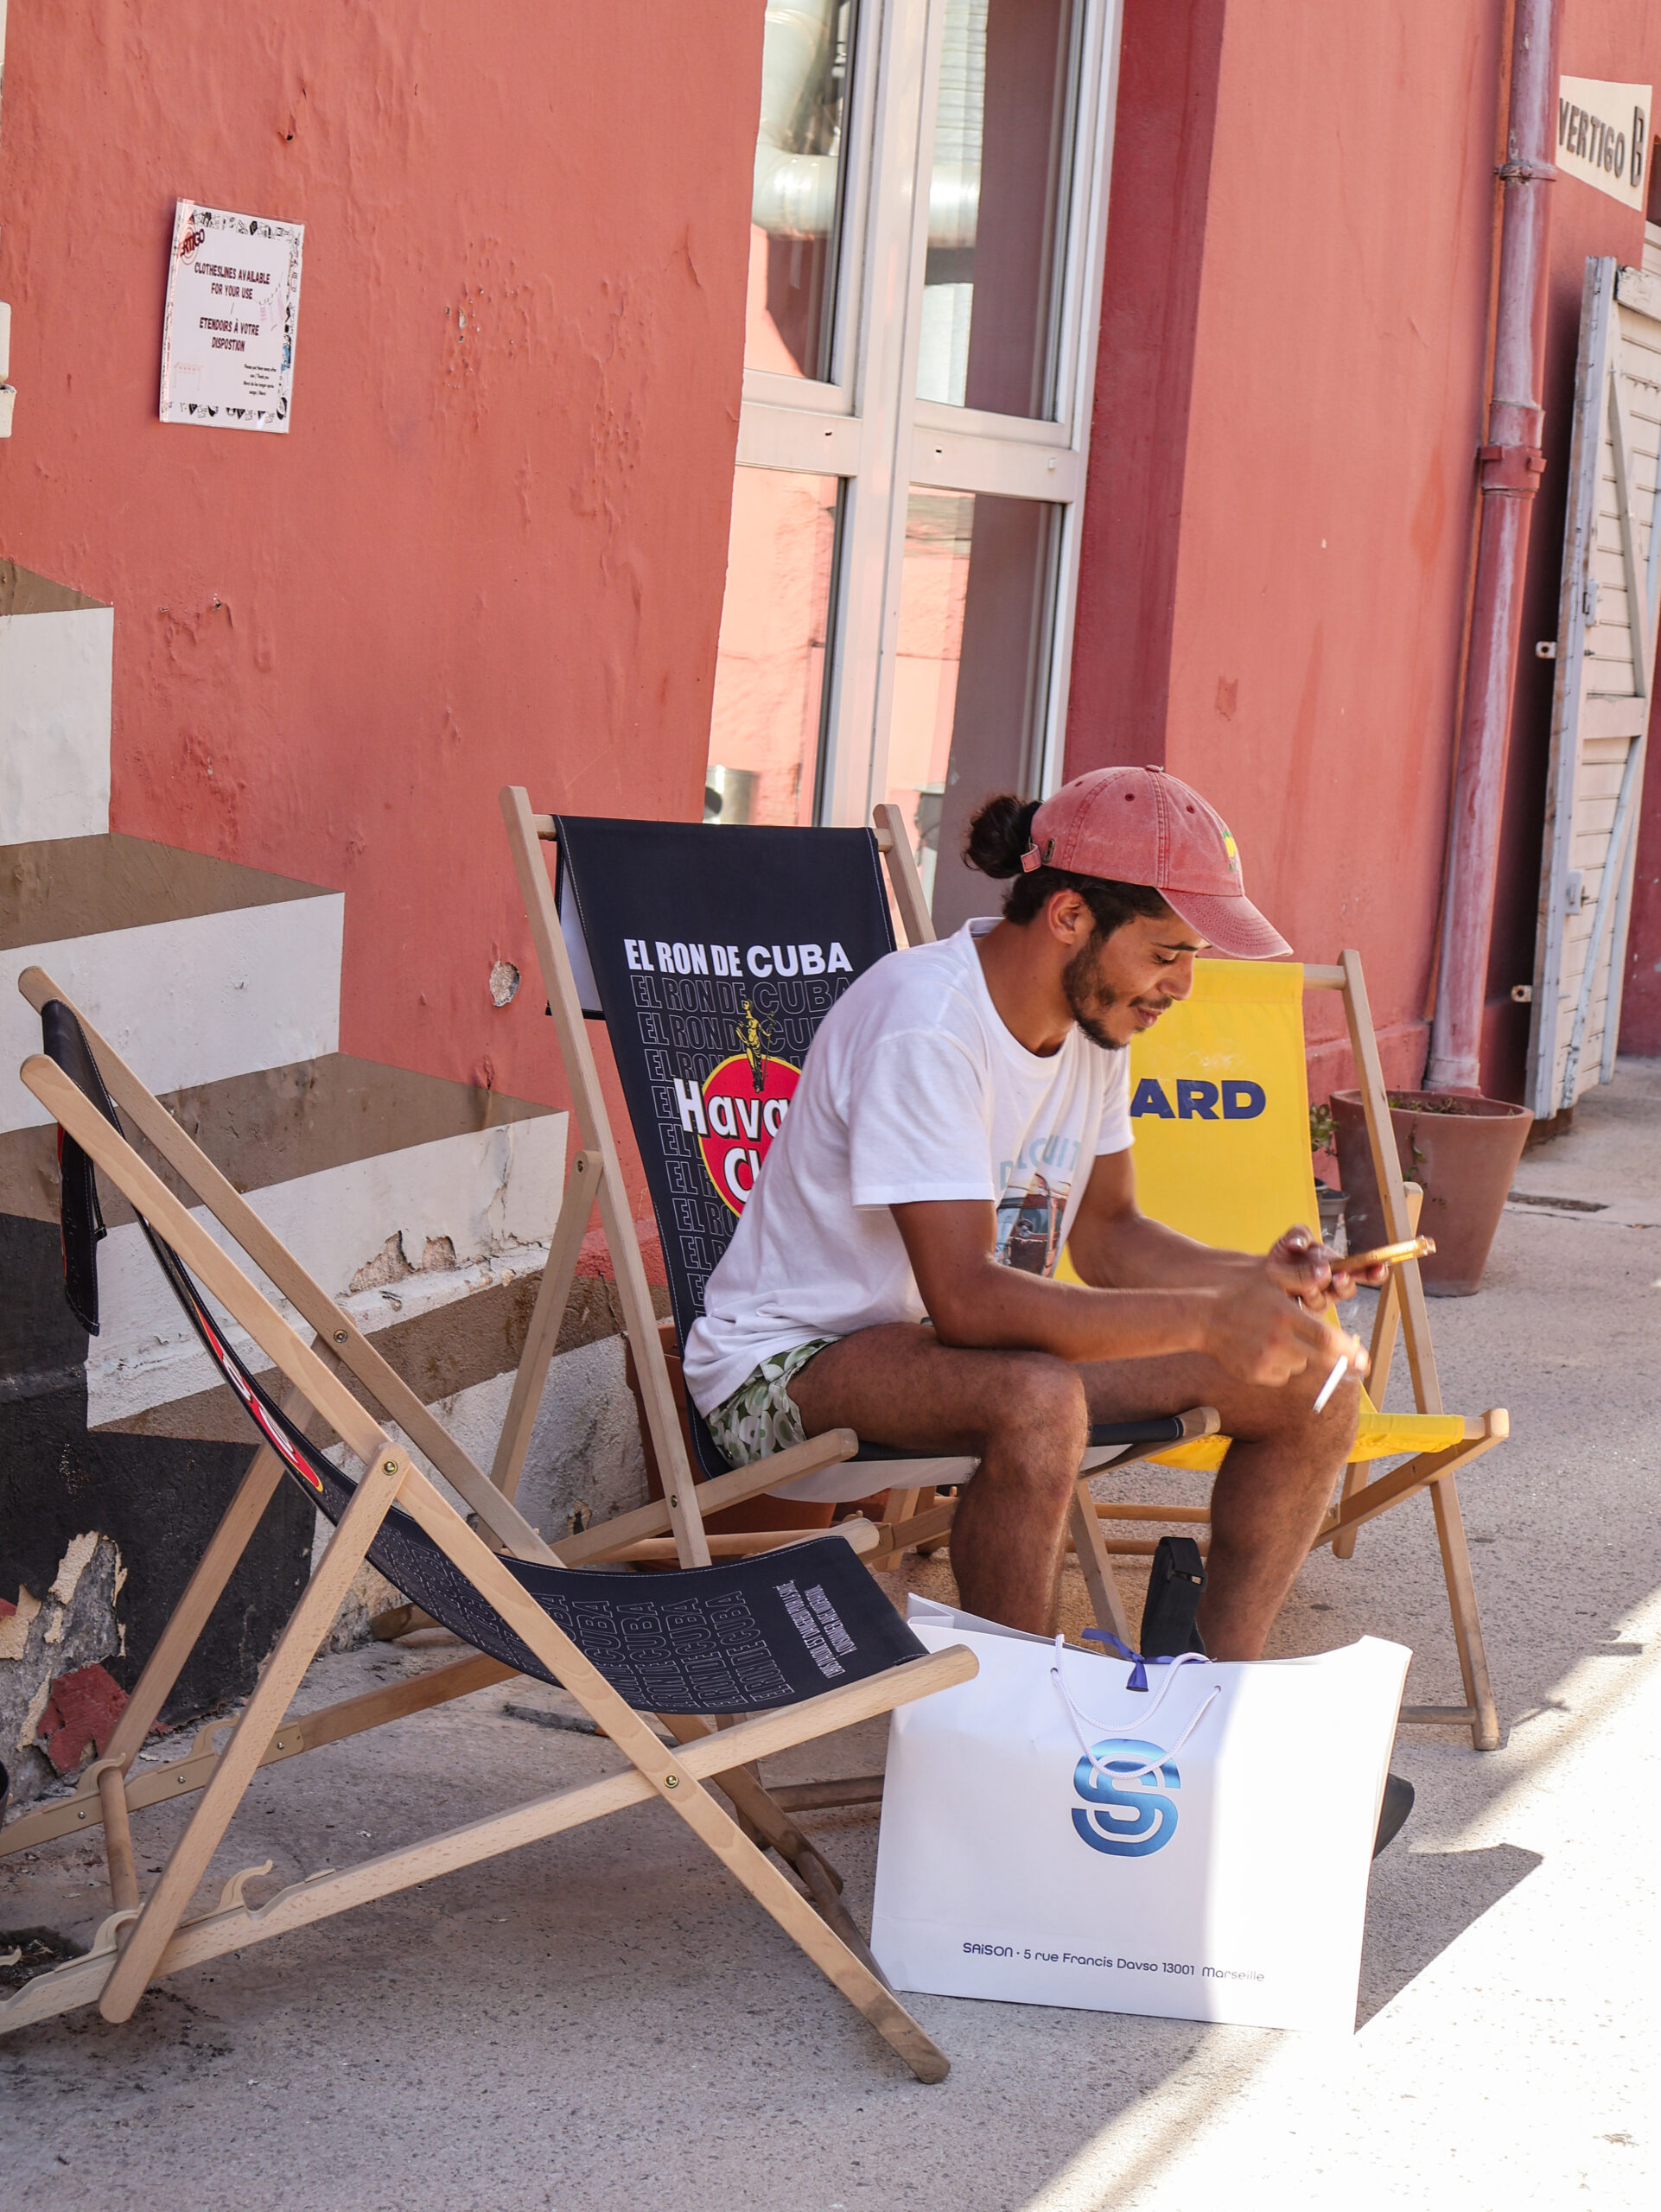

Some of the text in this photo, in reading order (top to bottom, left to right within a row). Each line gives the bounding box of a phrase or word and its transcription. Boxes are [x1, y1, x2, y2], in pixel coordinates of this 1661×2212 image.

[1559, 98, 1645, 188] VERTIGO B
[194, 262, 270, 284] CLOTHESLINES AVAILABLE
[211, 283, 253, 300] FOR YOUR USE
[200, 317, 232, 332] ETENDOIRS
[240, 322, 259, 336] VOTRE
[623, 938, 854, 978] EL RON DE CUBA
[630, 976, 662, 1008] EL
[662, 977, 716, 1014] RON
[716, 982, 748, 1015] DE
[637, 1013, 670, 1046] EL
[669, 1014, 723, 1051] RON
[645, 1049, 677, 1082] EL
[659, 1123, 691, 1158] EL
[665, 1160, 698, 1194] EL
[672, 1198, 705, 1232] EL
[679, 1236, 712, 1270] EL
[572, 1600, 626, 1662] CUBA
[616, 1602, 671, 1662] CUBA
[661, 1598, 716, 1656] CUBA
[681, 1651, 727, 1673] DE
[705, 1590, 795, 1702] EL RON DE CUBA
[643, 1676, 692, 1700] RON
[690, 1670, 740, 1700] RON
[1023, 1949, 1032, 1960] 5
[1035, 1952, 1060, 1962] rue
[1063, 1953, 1113, 1968] Francis
[1117, 1958, 1158, 1972] Davso
[1162, 1962, 1195, 1976] 13001
[1202, 1967, 1265, 1982] Marseille
